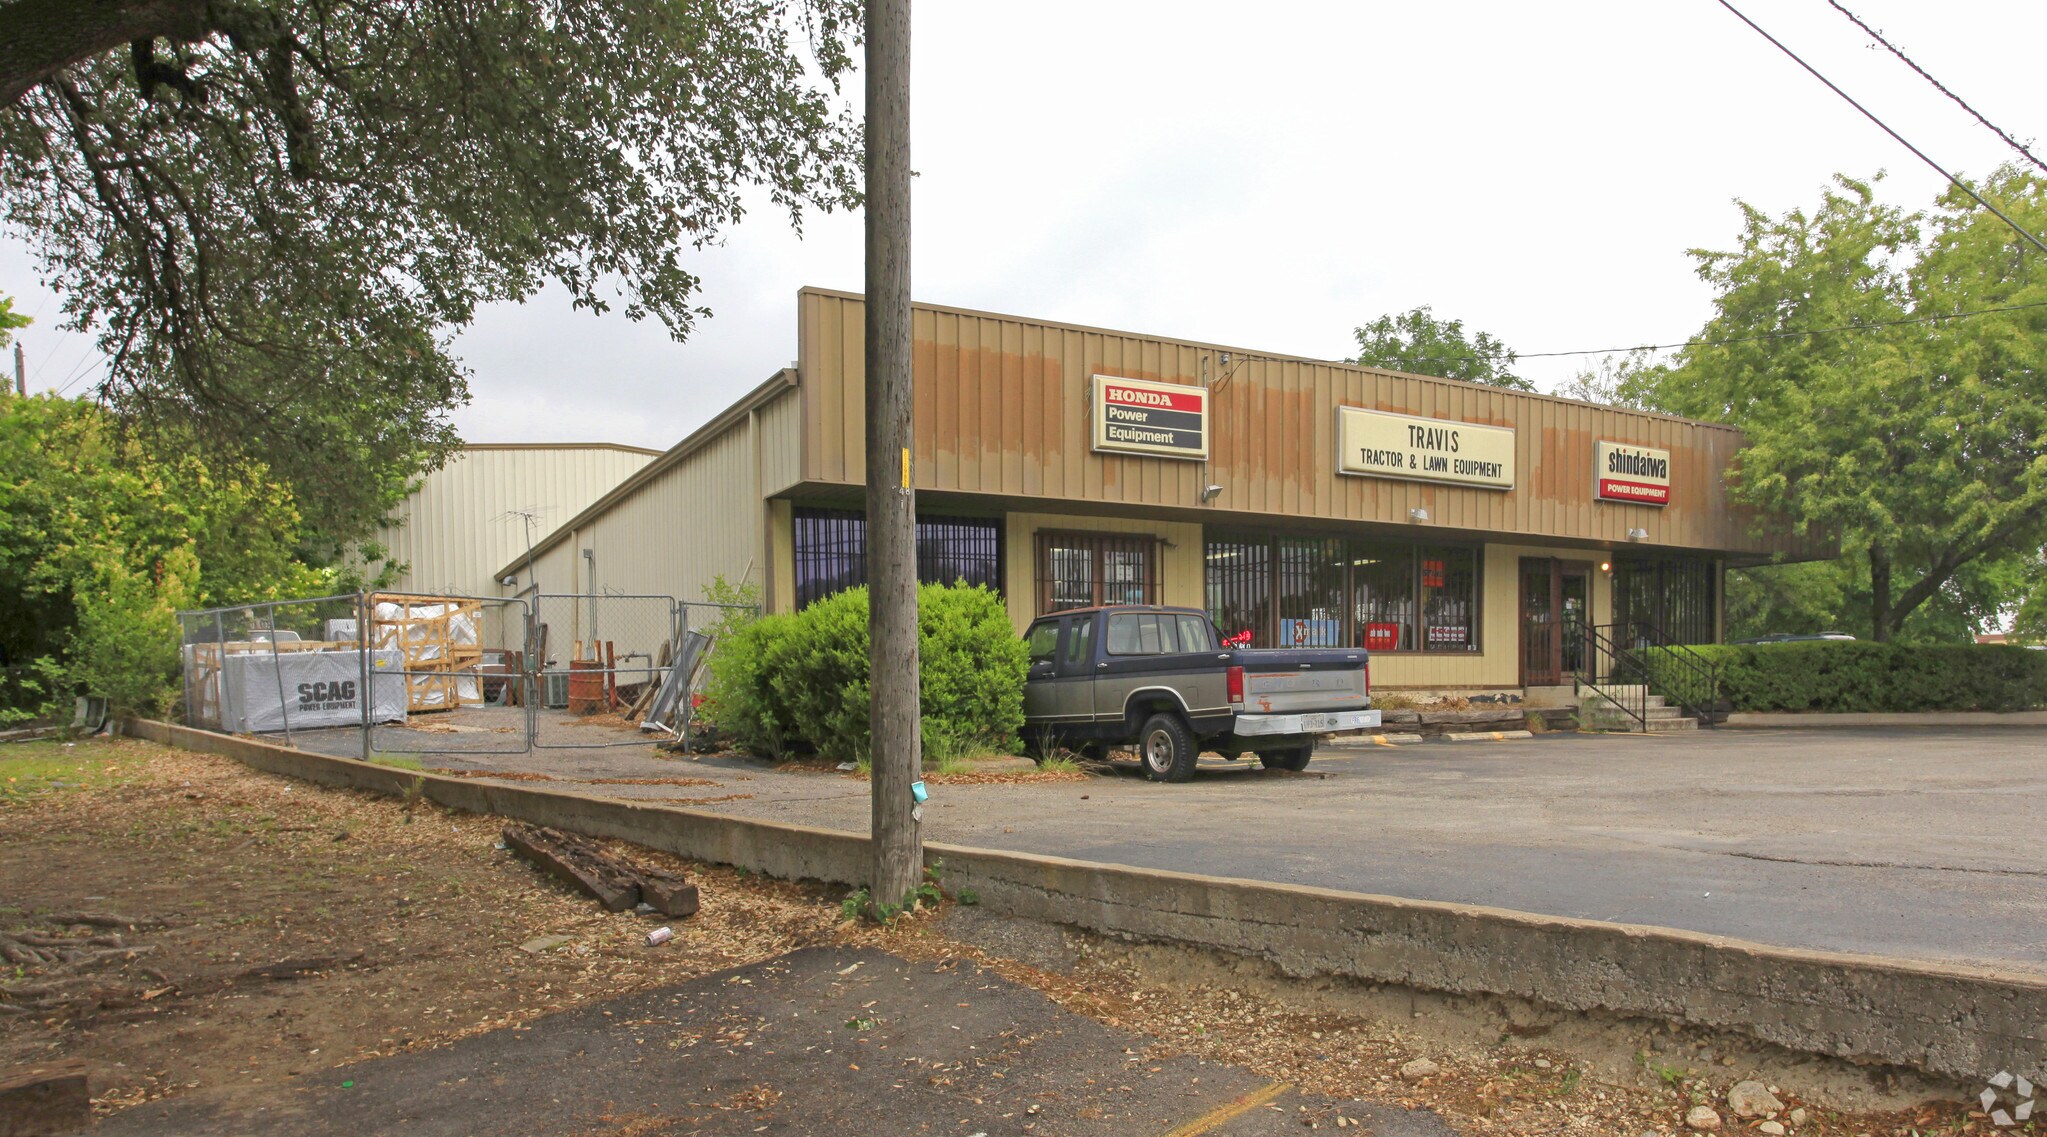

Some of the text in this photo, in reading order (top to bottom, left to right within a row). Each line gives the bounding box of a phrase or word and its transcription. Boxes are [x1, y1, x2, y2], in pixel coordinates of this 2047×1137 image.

[1109, 388, 1172, 406] HONDA
[1109, 407, 1148, 422] Power
[1109, 426, 1174, 443] Equipment
[1408, 424, 1459, 453] TRAVIS
[1360, 448, 1503, 478] TRACTOR & LAWN EQUIPMENT
[1609, 448, 1666, 479] shindaiwa
[1608, 484, 1666, 497] POWER EQUIPMENT
[298, 681, 355, 702] SCAG
[299, 702, 356, 712] POWER EQUIPMENT
